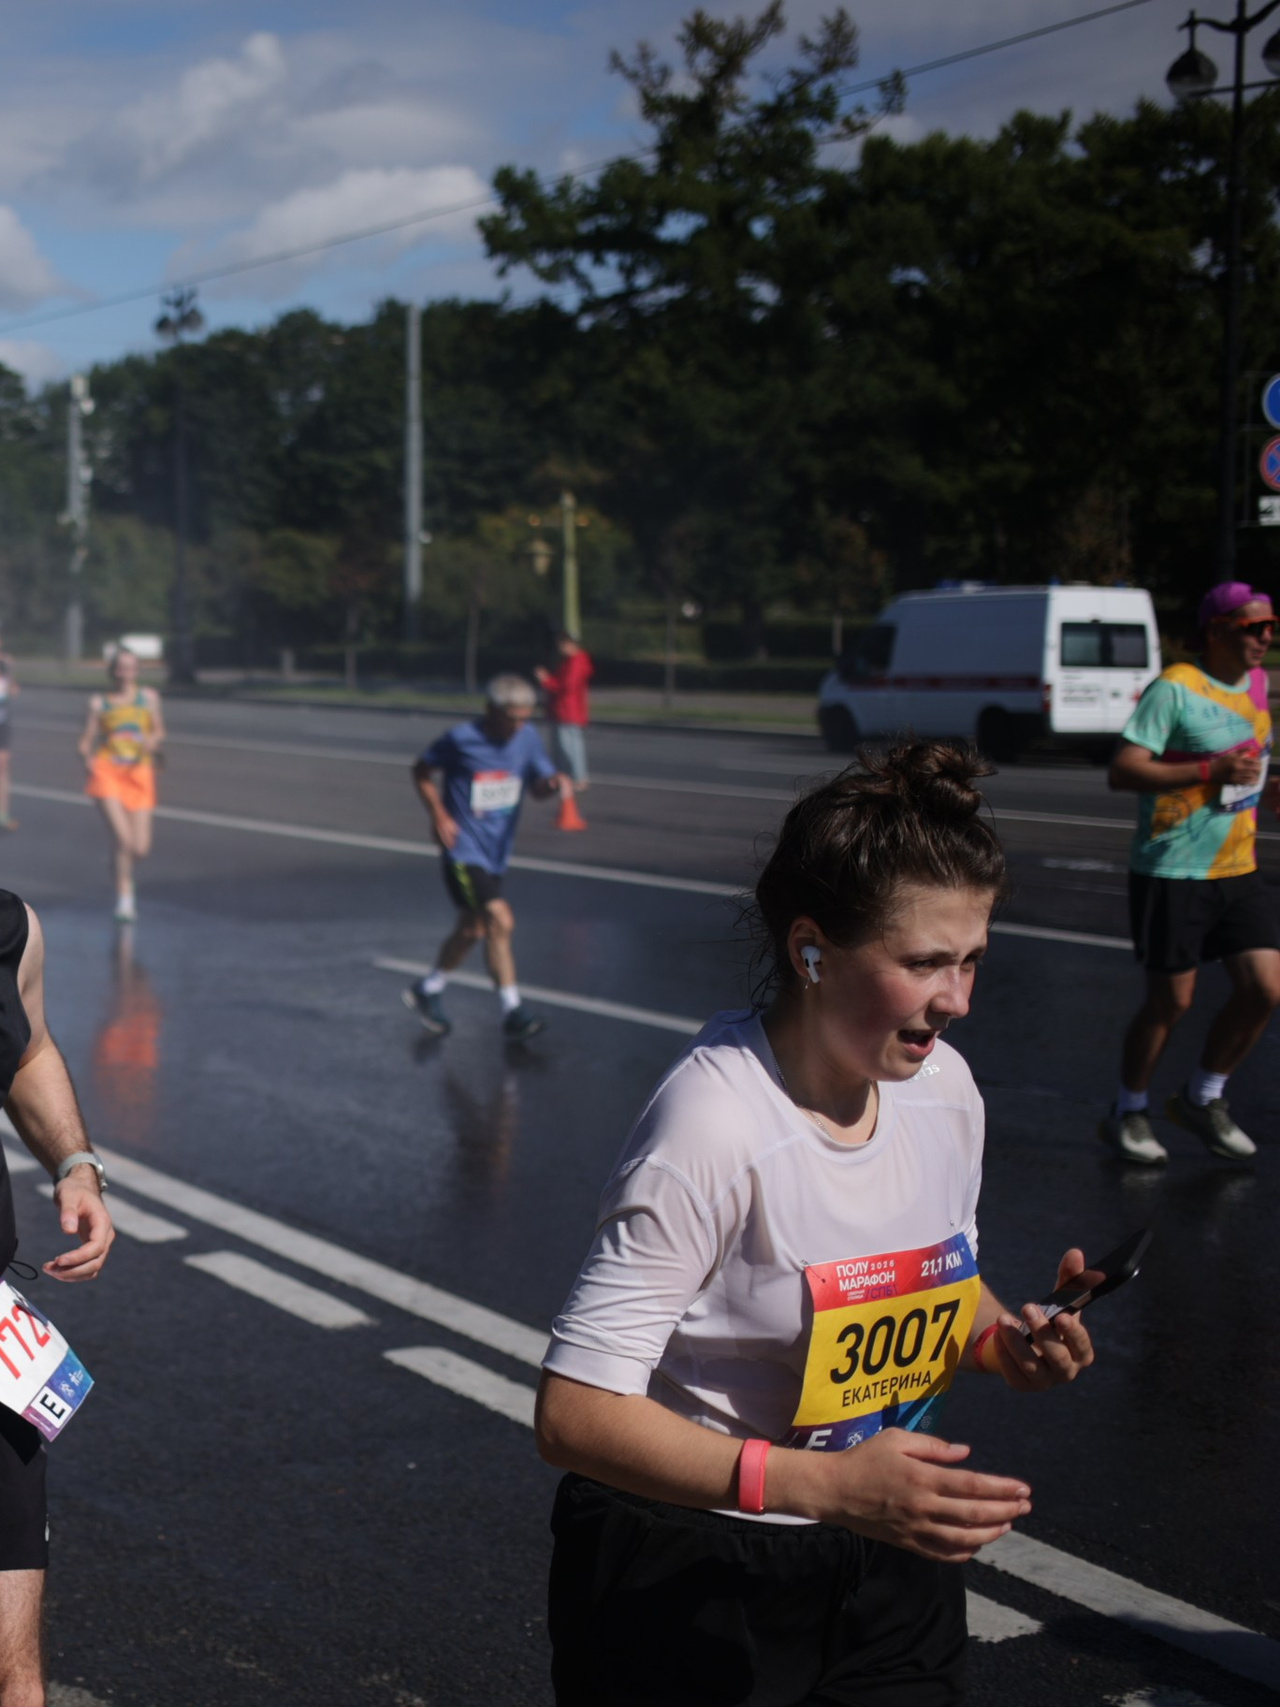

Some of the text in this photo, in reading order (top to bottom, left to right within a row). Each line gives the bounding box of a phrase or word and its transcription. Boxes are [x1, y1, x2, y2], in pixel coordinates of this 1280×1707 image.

[836, 1260, 869, 1278] ПОЛУ
[920, 1257, 943, 1278] 21,1
[839, 1270, 896, 1292] МАРАФОН
[830, 1298, 961, 1384] 3007
[842, 1370, 933, 1408] ЕКАТЕРИНА
